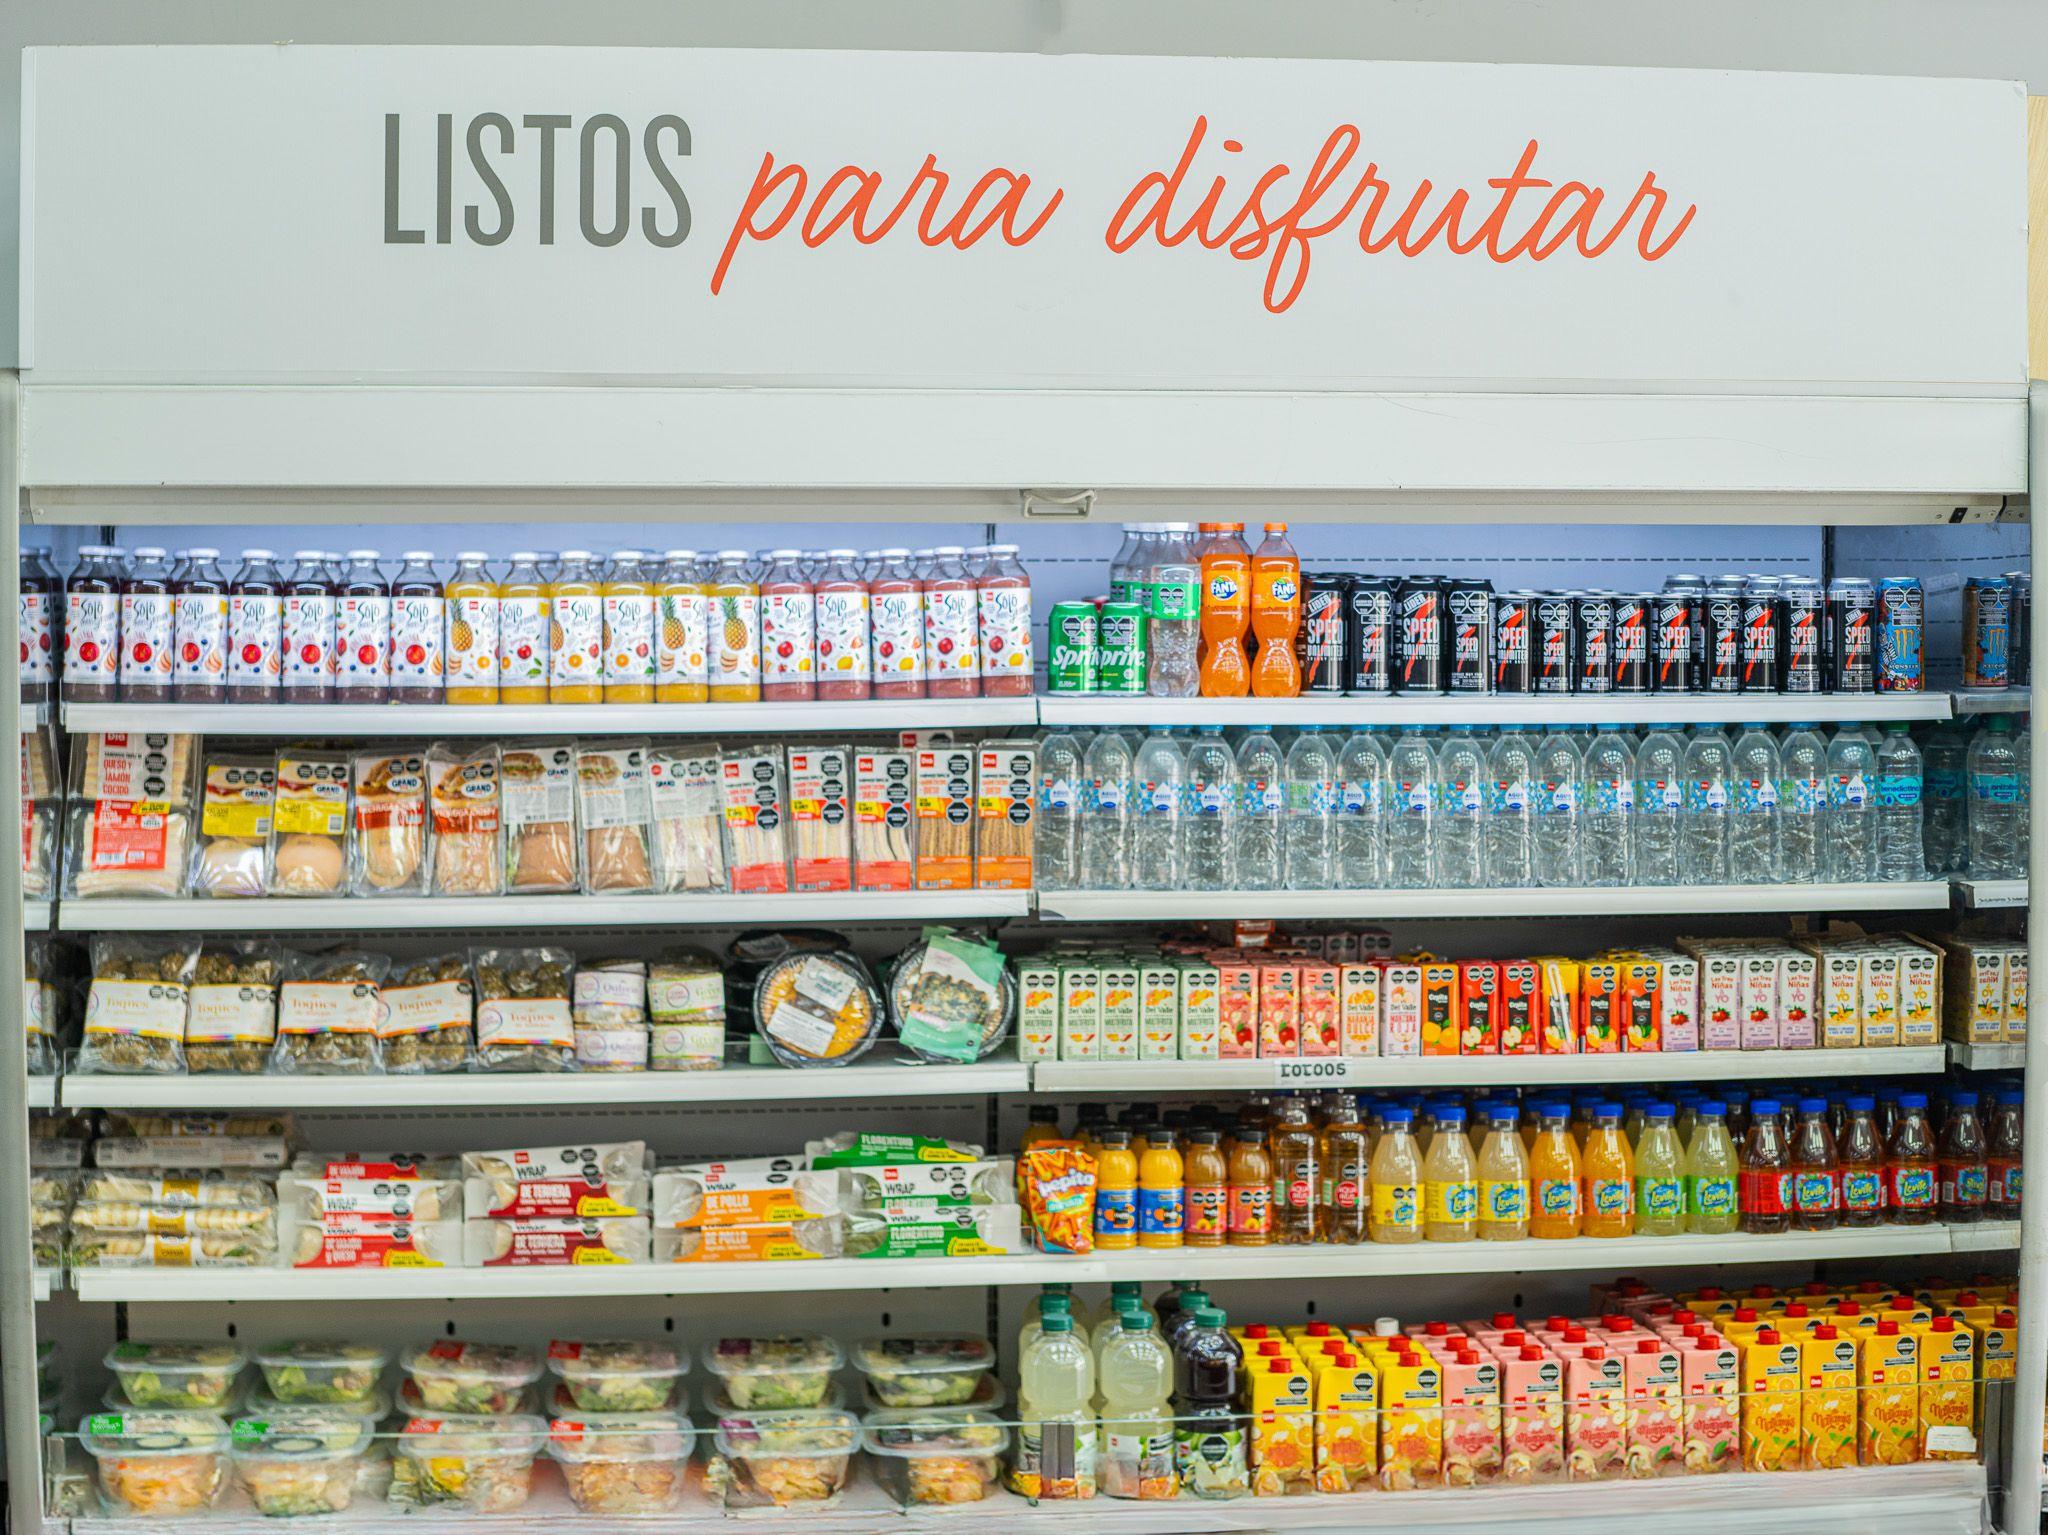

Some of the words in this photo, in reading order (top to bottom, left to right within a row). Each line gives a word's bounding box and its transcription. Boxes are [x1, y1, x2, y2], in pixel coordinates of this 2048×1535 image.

[384, 112, 691, 247] LISTOS
[711, 152, 1063, 296] para
[1106, 116, 1696, 314] disfrutar
[1403, 618, 1440, 643] SPEED
[1498, 626, 1528, 649] SPEED
[1616, 627, 1646, 648] SPEED
[1659, 627, 1690, 648] SPEED
[1744, 627, 1775, 648] SPEED
[1100, 646, 1145, 670] prite
[391, 779, 417, 788] GRAND
[1715, 995, 1729, 1003] YO
[1792, 993, 1805, 1001] YO
[1835, 993, 1850, 1001] YO
[1875, 992, 1888, 1001] YO
[1913, 990, 1927, 999] YO
[861, 1134, 914, 1147] FLORENTINO
[516, 1165, 547, 1179] WRAP
[891, 1226, 945, 1240] FLORENTINO
